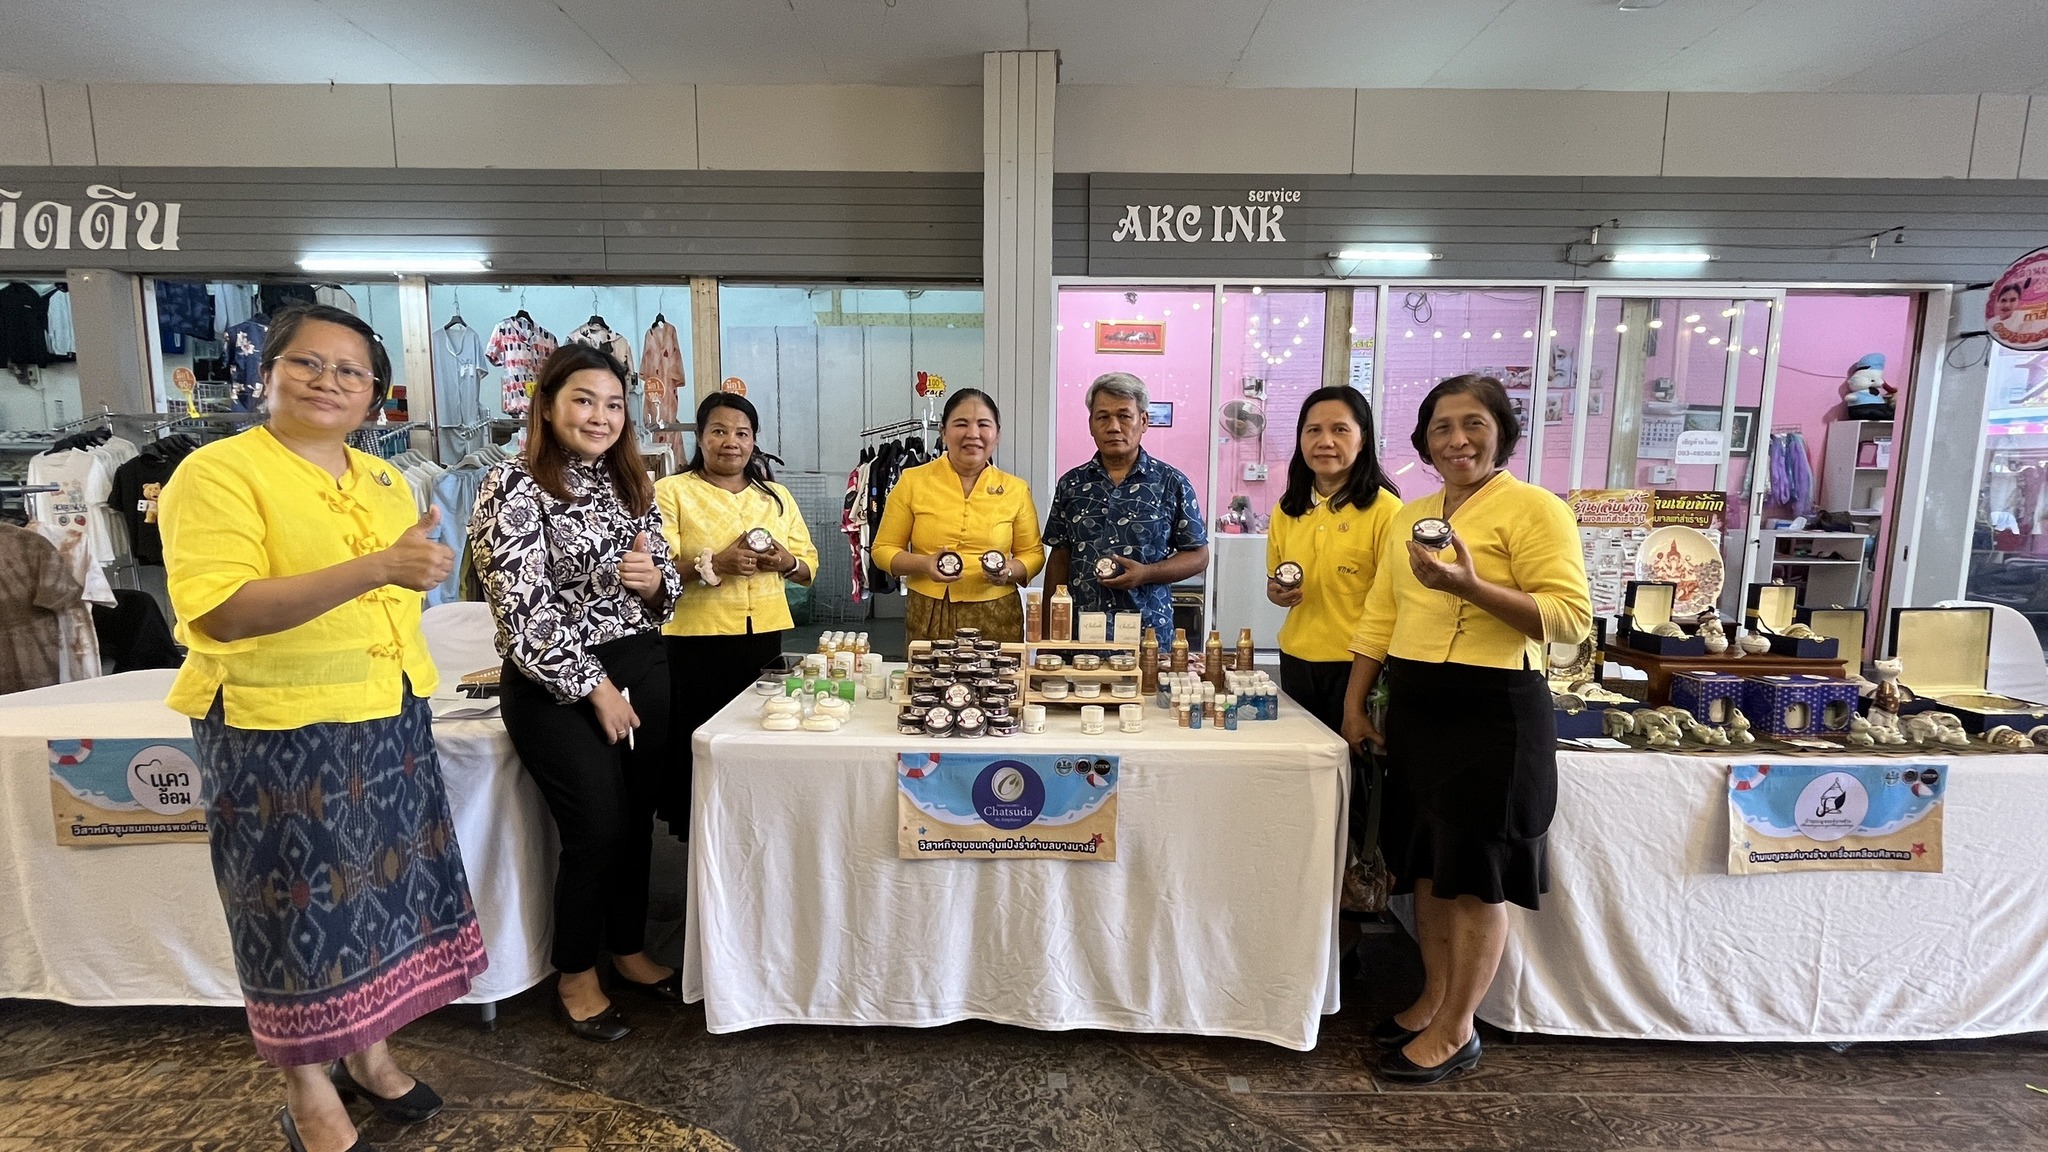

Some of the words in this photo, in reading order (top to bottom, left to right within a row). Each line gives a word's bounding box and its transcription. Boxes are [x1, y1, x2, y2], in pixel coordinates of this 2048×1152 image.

[1248, 187, 1301, 202] service
[1112, 204, 1203, 242] AKC
[1211, 204, 1287, 242] INK
[983, 806, 1033, 817] Chatsuda
